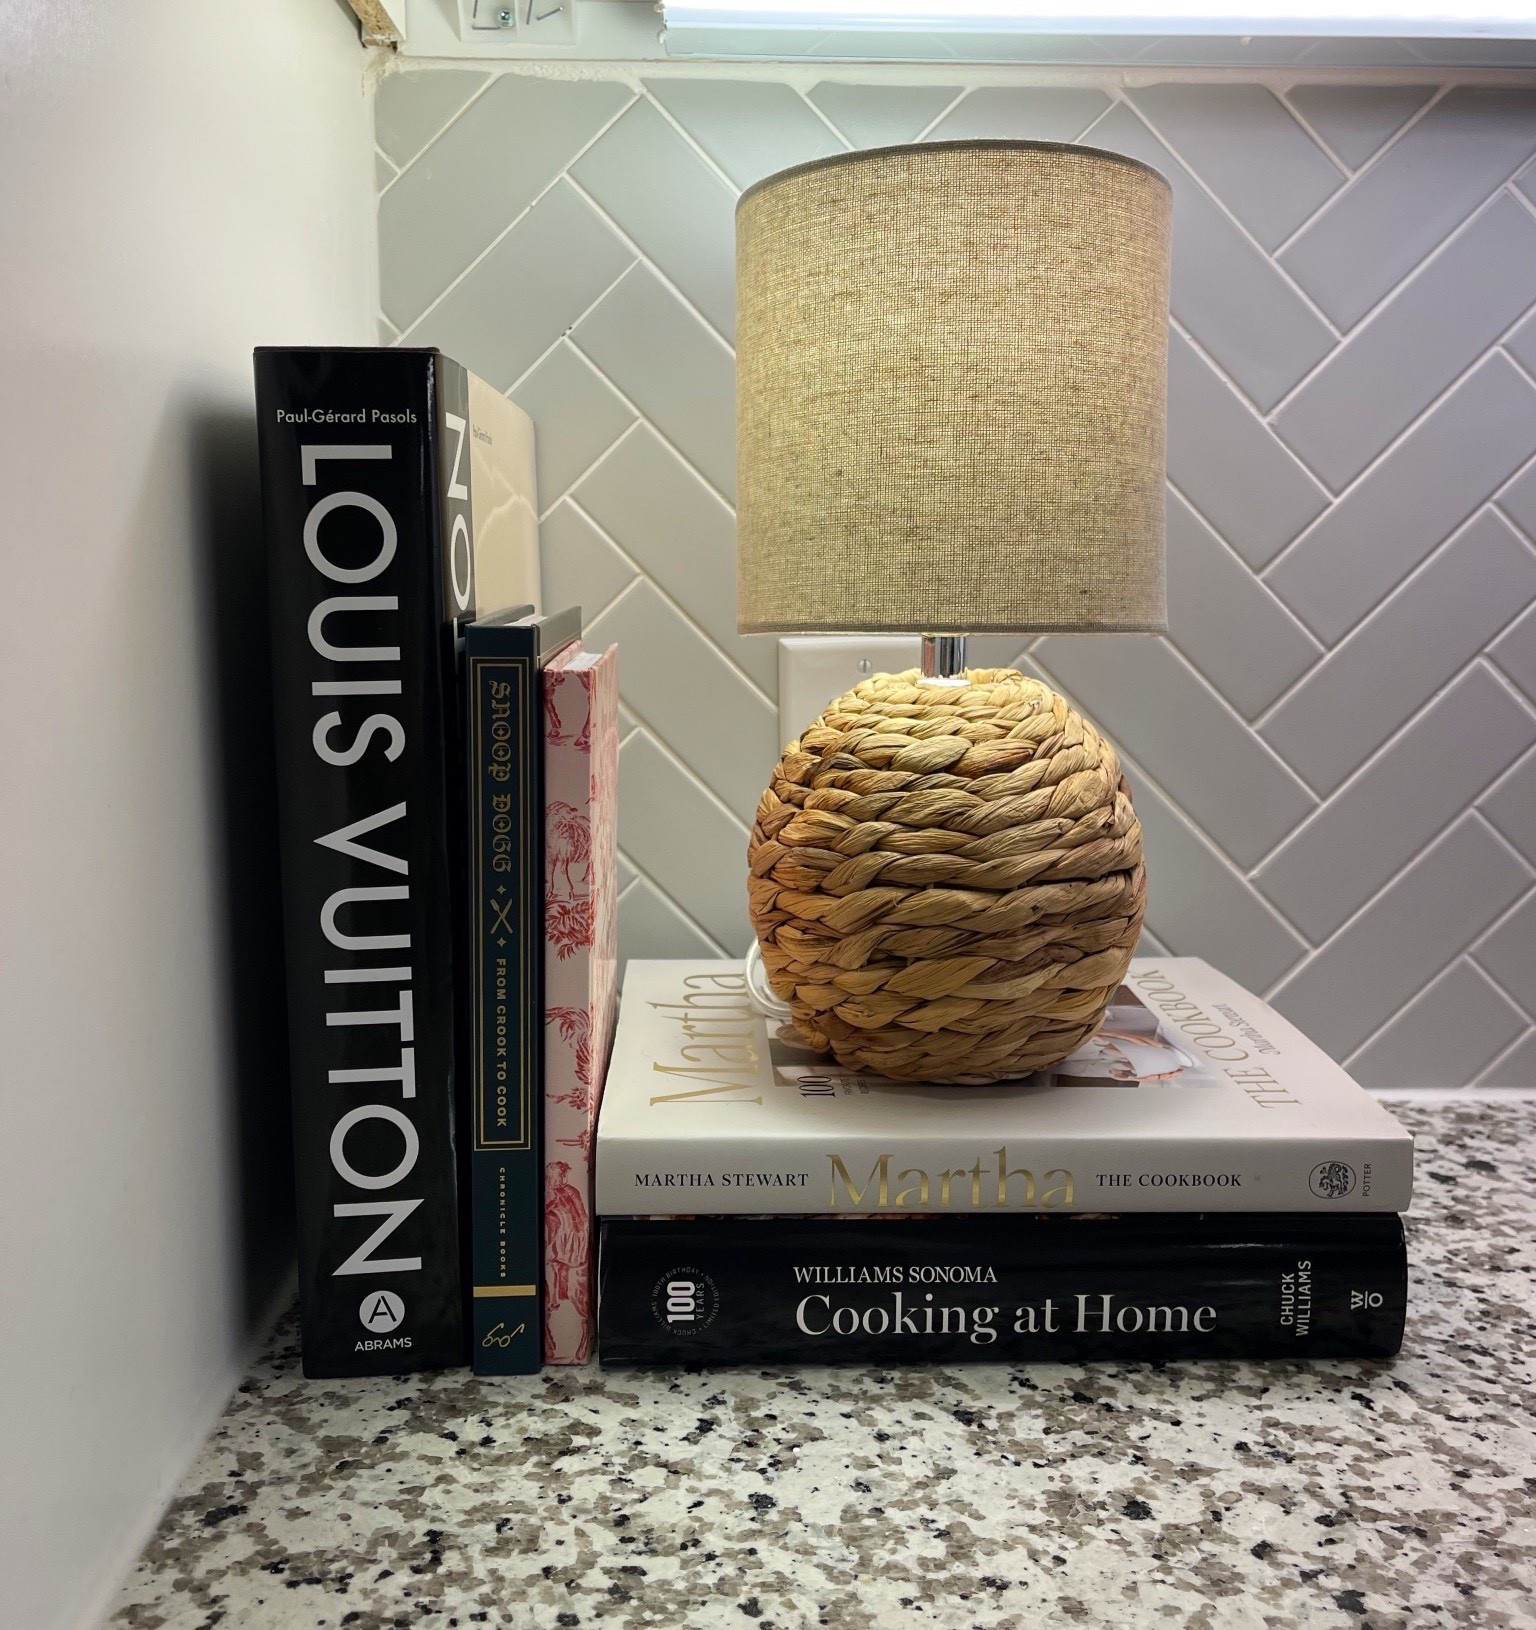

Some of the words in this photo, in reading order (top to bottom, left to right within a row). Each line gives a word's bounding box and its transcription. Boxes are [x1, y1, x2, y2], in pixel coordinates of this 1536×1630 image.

[276, 408, 367, 424] Paul-Gérard
[371, 408, 418, 423] Pasols
[300, 444, 406, 767] LOUIS
[488, 680, 512, 782] SNOOP
[492, 793, 512, 873] DOGG
[496, 958, 507, 1000] FROM
[496, 1005, 507, 1057] CROOK
[1130, 969, 1250, 1062] COOKBOOK
[313, 801, 425, 1277] VUITTON
[645, 973, 763, 1107] Martha
[496, 1061, 507, 1081] TO
[797, 1075, 836, 1098] 100
[1223, 1066, 1302, 1109] THE
[496, 1085, 508, 1128] COOK
[634, 1173, 715, 1187] MARTHA
[721, 1173, 809, 1187] STEWART
[826, 1145, 1076, 1208] Martha
[1095, 1173, 1133, 1187] THE
[1138, 1173, 1243, 1188] COOKBOOK
[1361, 1163, 1372, 1197] POTTER
[792, 1266, 904, 1284] WILLIAMS
[908, 1266, 998, 1284] SONOMA
[666, 1281, 696, 1324] 100
[695, 1282, 705, 1320] YEARS
[795, 1291, 1000, 1345] Cooking
[1013, 1298, 1060, 1333] at
[1072, 1294, 1218, 1333] Home
[1280, 1272, 1295, 1326] CHUCK
[1295, 1260, 1312, 1337] WILLIAMS
[354, 1337, 412, 1352] ABRAMS
